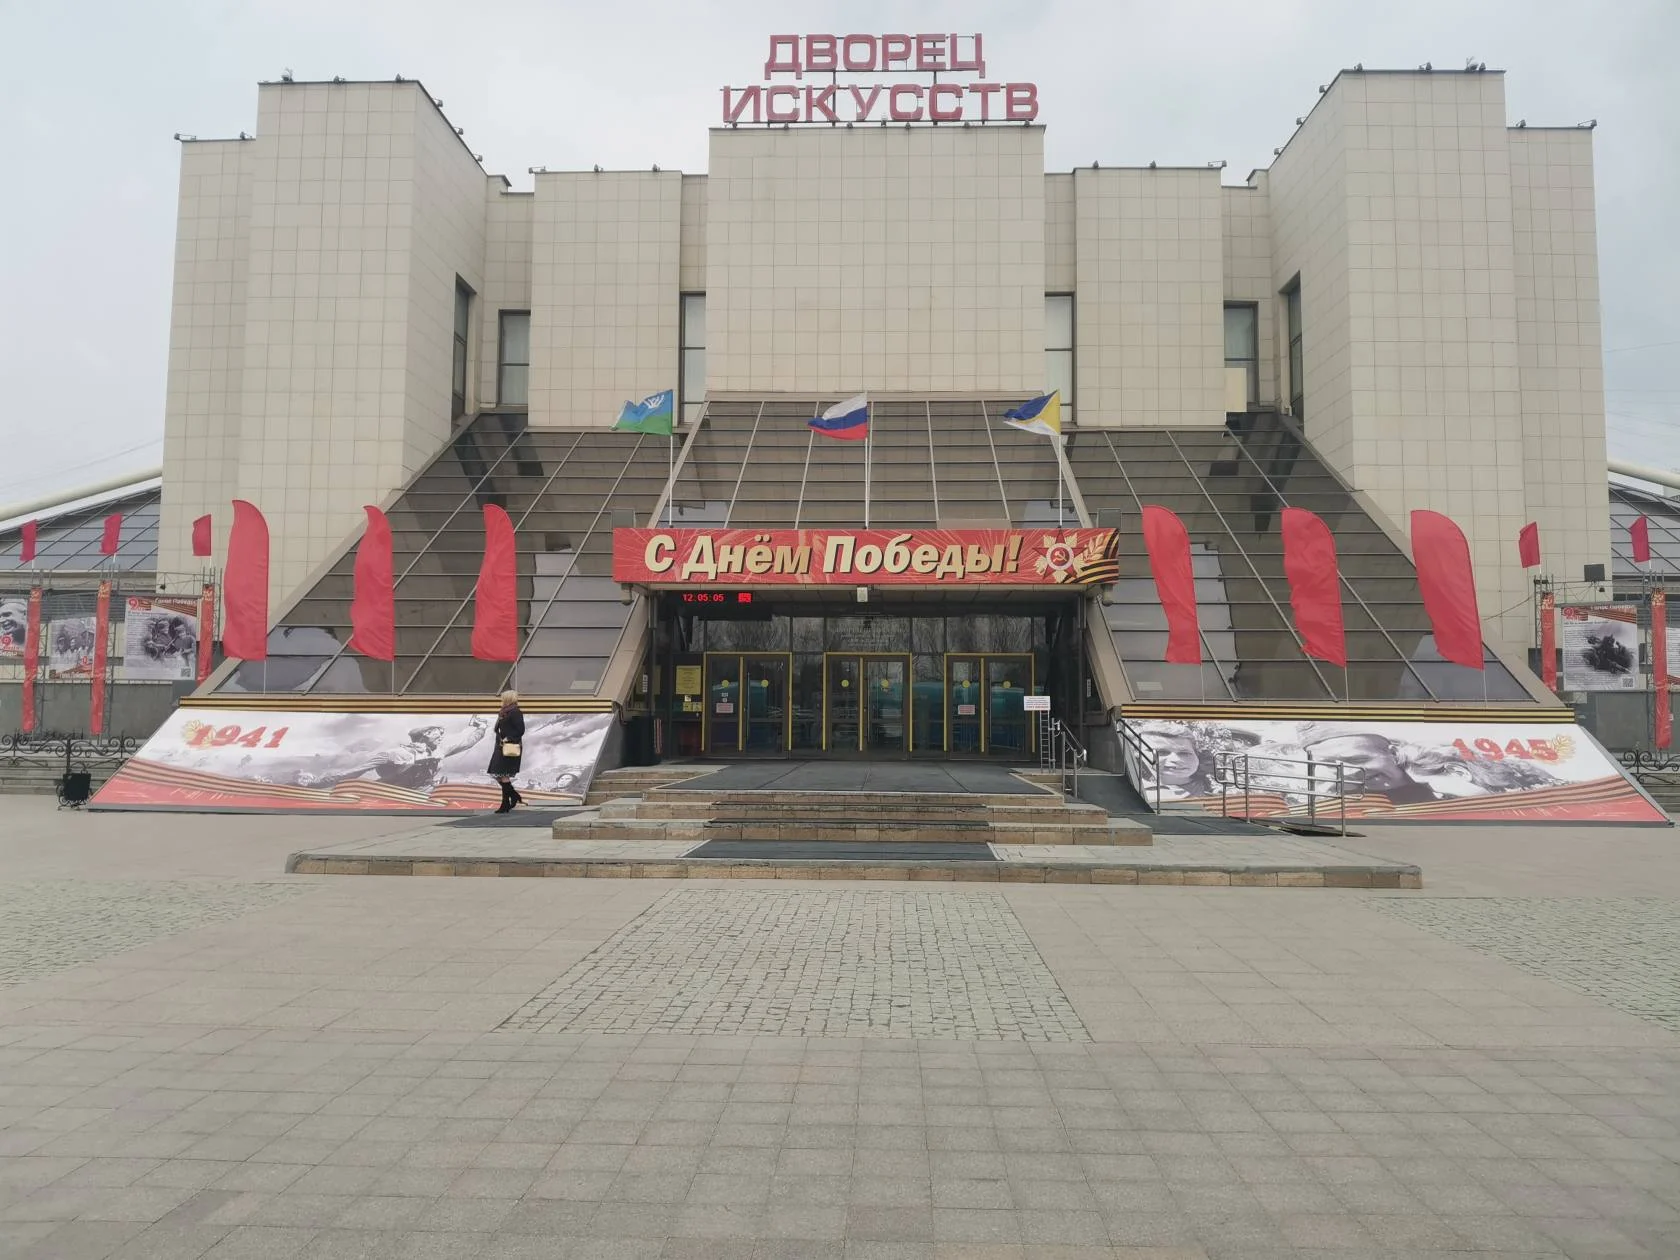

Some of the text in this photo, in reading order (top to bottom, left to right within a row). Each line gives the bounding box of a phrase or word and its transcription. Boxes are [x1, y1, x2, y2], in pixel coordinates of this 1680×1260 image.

[764, 33, 985, 80] ДВОРЕЦ
[722, 83, 1039, 122] ИСКУССТВ
[644, 533, 1024, 581] С Днём Победы!
[186, 724, 290, 749] 1941
[1452, 738, 1559, 761] 1945
